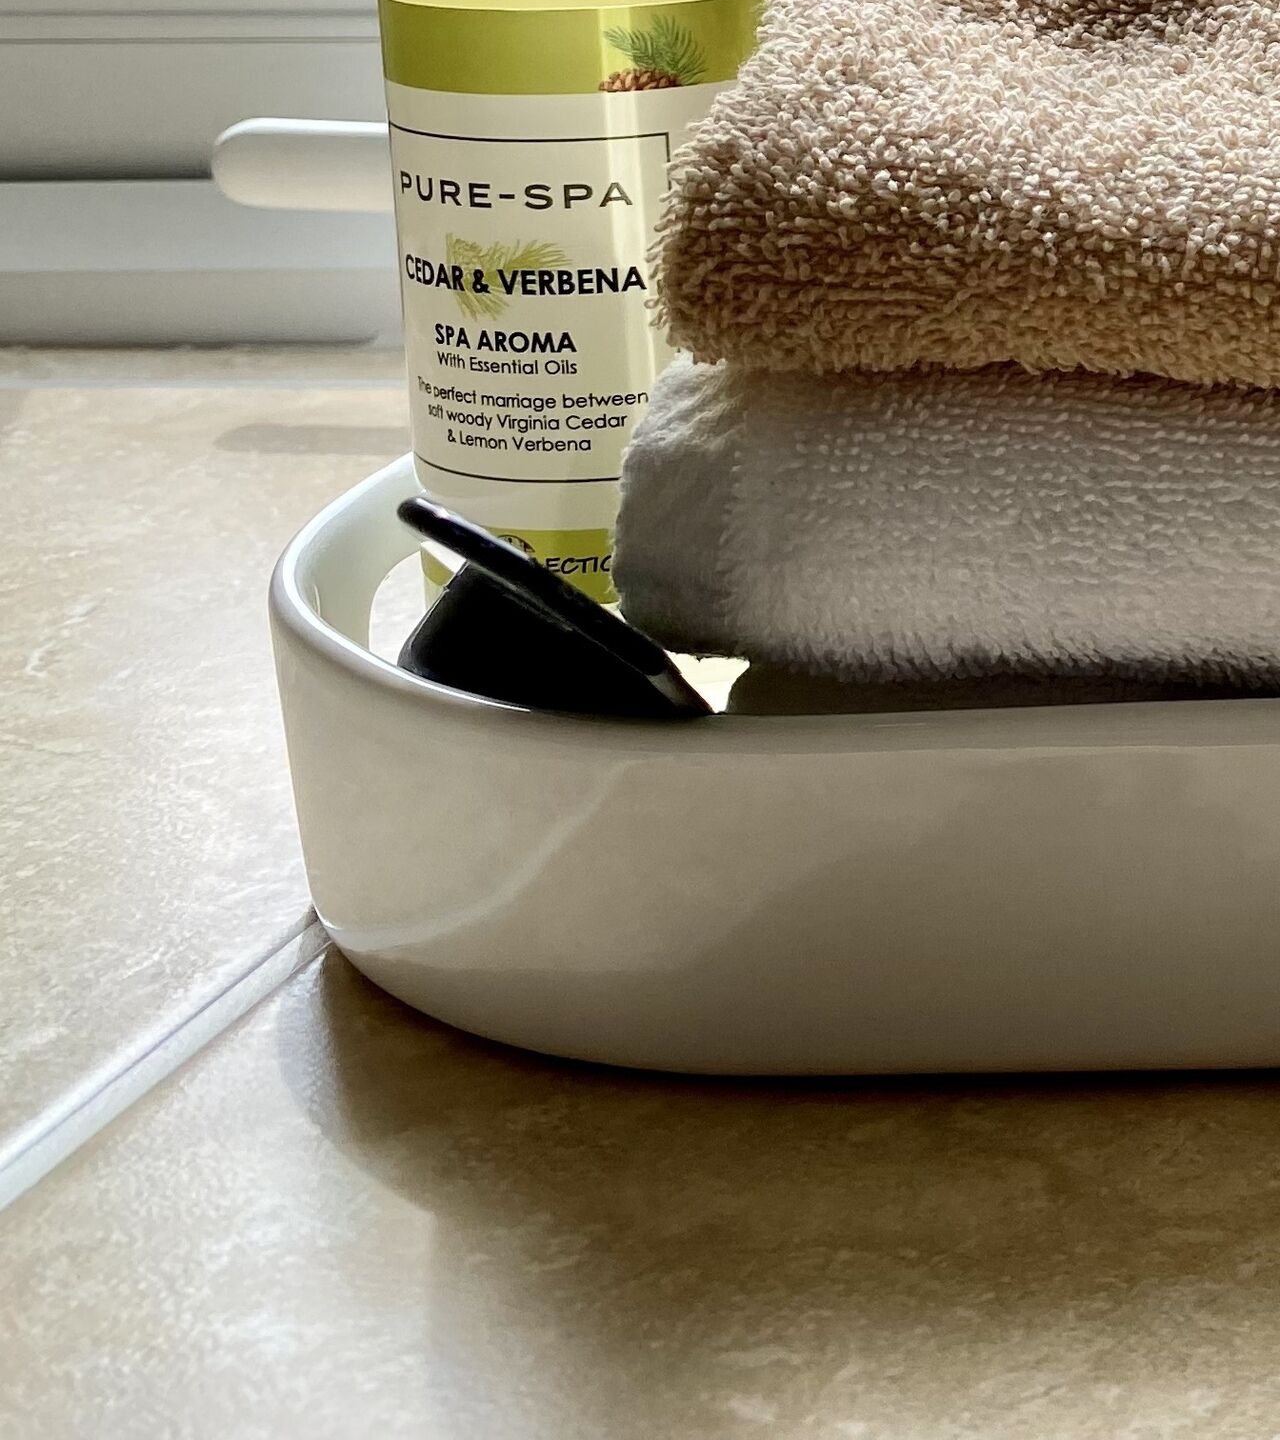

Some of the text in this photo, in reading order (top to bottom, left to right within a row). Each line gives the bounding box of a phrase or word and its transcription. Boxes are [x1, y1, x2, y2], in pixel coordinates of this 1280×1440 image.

[400, 170, 633, 210] PURE-SPA
[405, 253, 648, 296] CEDAR & VERBENA
[435, 323, 577, 353] SPA AROMA
[437, 351, 578, 375] With Essential Oils
[433, 386, 477, 404] perfect
[481, 393, 556, 413] marriage
[562, 392, 649, 409] between
[446, 412, 493, 431] woody
[496, 414, 560, 434] Virginia
[565, 413, 628, 430] Cedar
[447, 428, 592, 452] & Lemon Verbena
